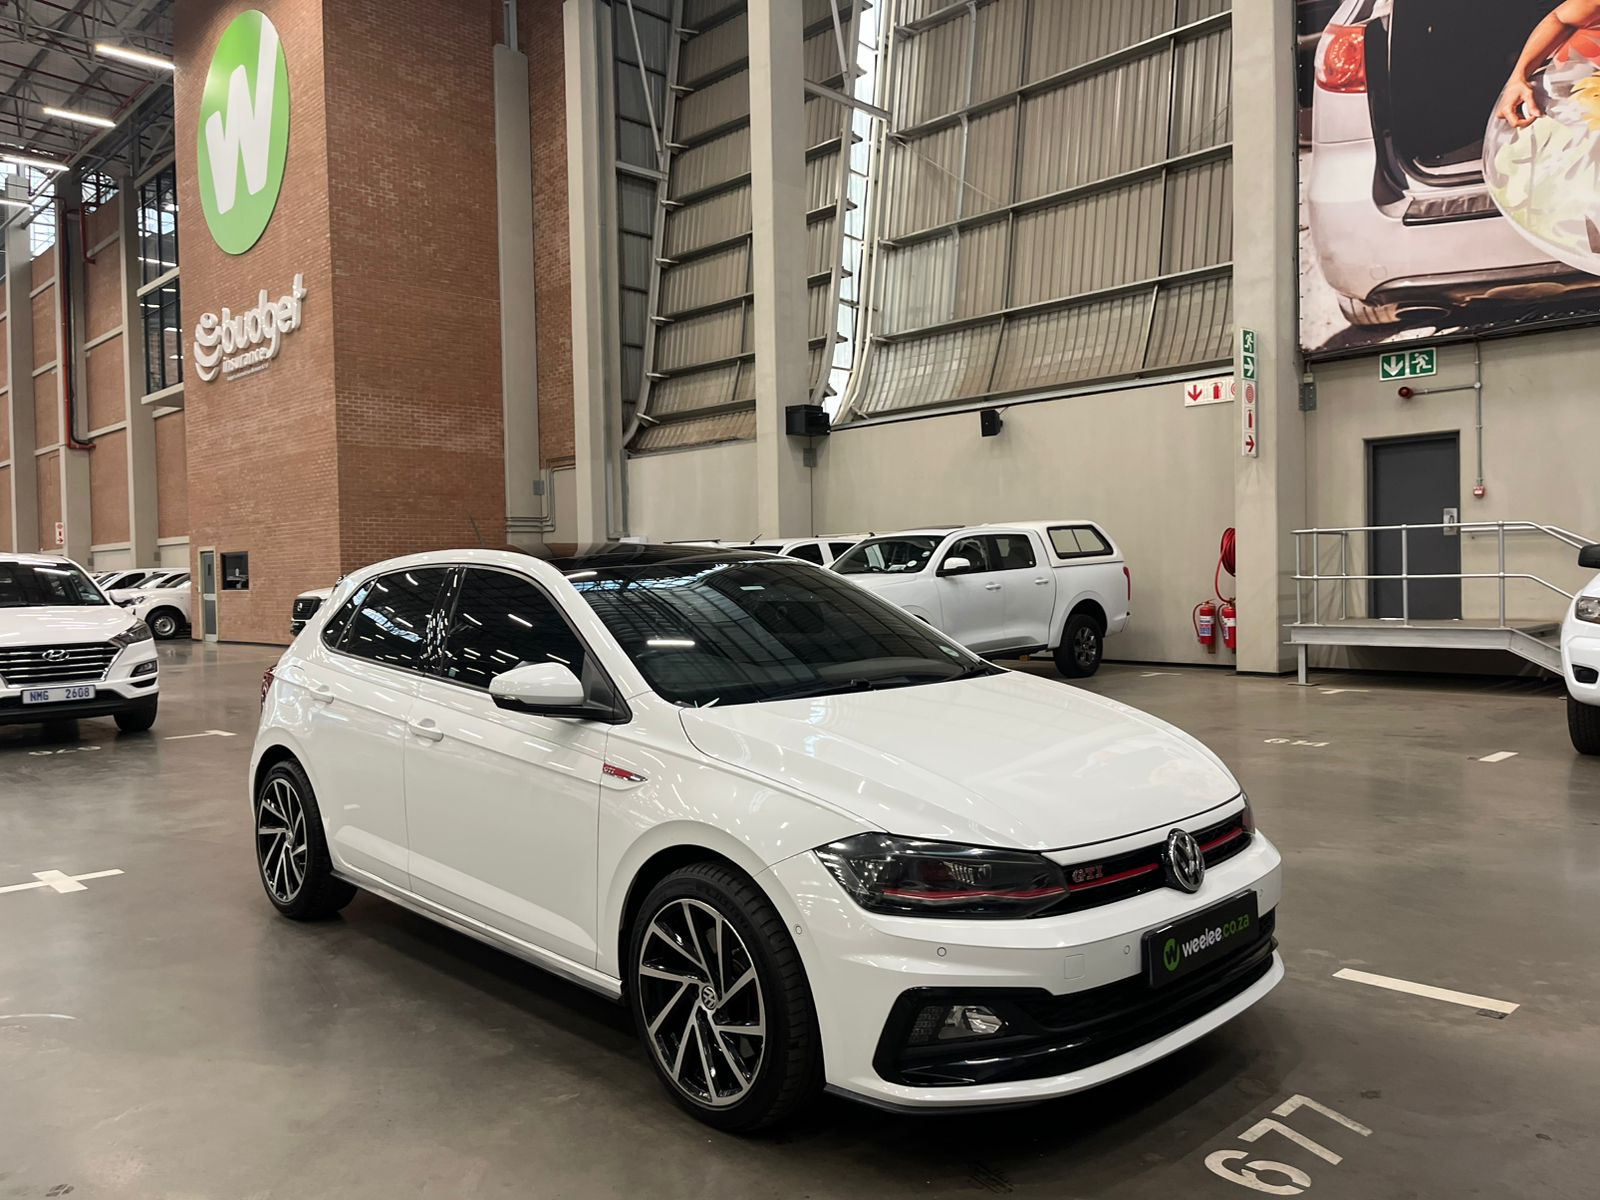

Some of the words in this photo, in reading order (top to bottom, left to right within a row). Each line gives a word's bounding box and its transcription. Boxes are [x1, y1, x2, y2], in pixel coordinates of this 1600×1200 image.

[222, 273, 307, 359] budget
[30, 690, 49, 702] NMG
[65, 687, 90, 699] 2608
[1072, 864, 1104, 883] GTI
[1181, 914, 1250, 958] weelee.co.za
[1204, 1093, 1374, 1196] 677
